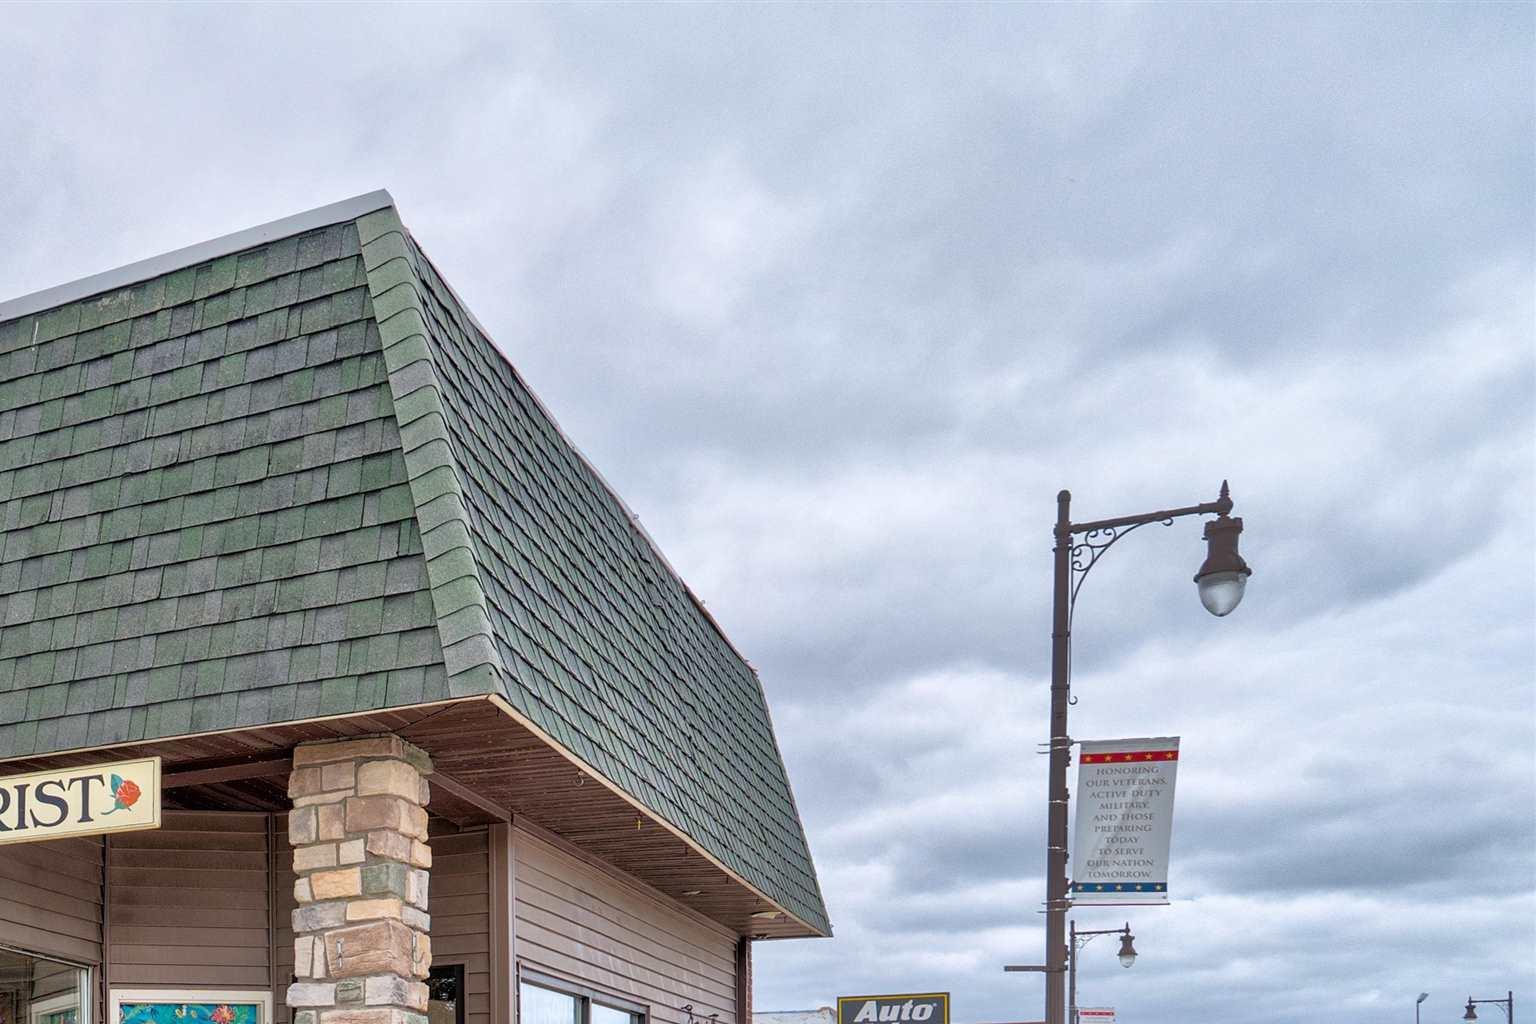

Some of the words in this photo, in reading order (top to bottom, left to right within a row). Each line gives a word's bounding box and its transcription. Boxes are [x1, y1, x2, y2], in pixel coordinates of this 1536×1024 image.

[1096, 767, 1160, 775] HONORING
[1086, 779, 1110, 788] OUR
[1090, 790, 1127, 799] ACTIVE
[1131, 789, 1162, 798] DUTY
[1094, 814, 1118, 822] AND
[1121, 813, 1153, 821] THOSE
[1094, 824, 1152, 833] PREPARING
[1105, 836, 1139, 844] TODAY
[1099, 848, 1112, 856] TO
[1113, 847, 1145, 856] SERVE
[1086, 860, 1111, 868] OUR
[1112, 859, 1154, 867] NATION
[853, 999, 934, 1022] Auto
